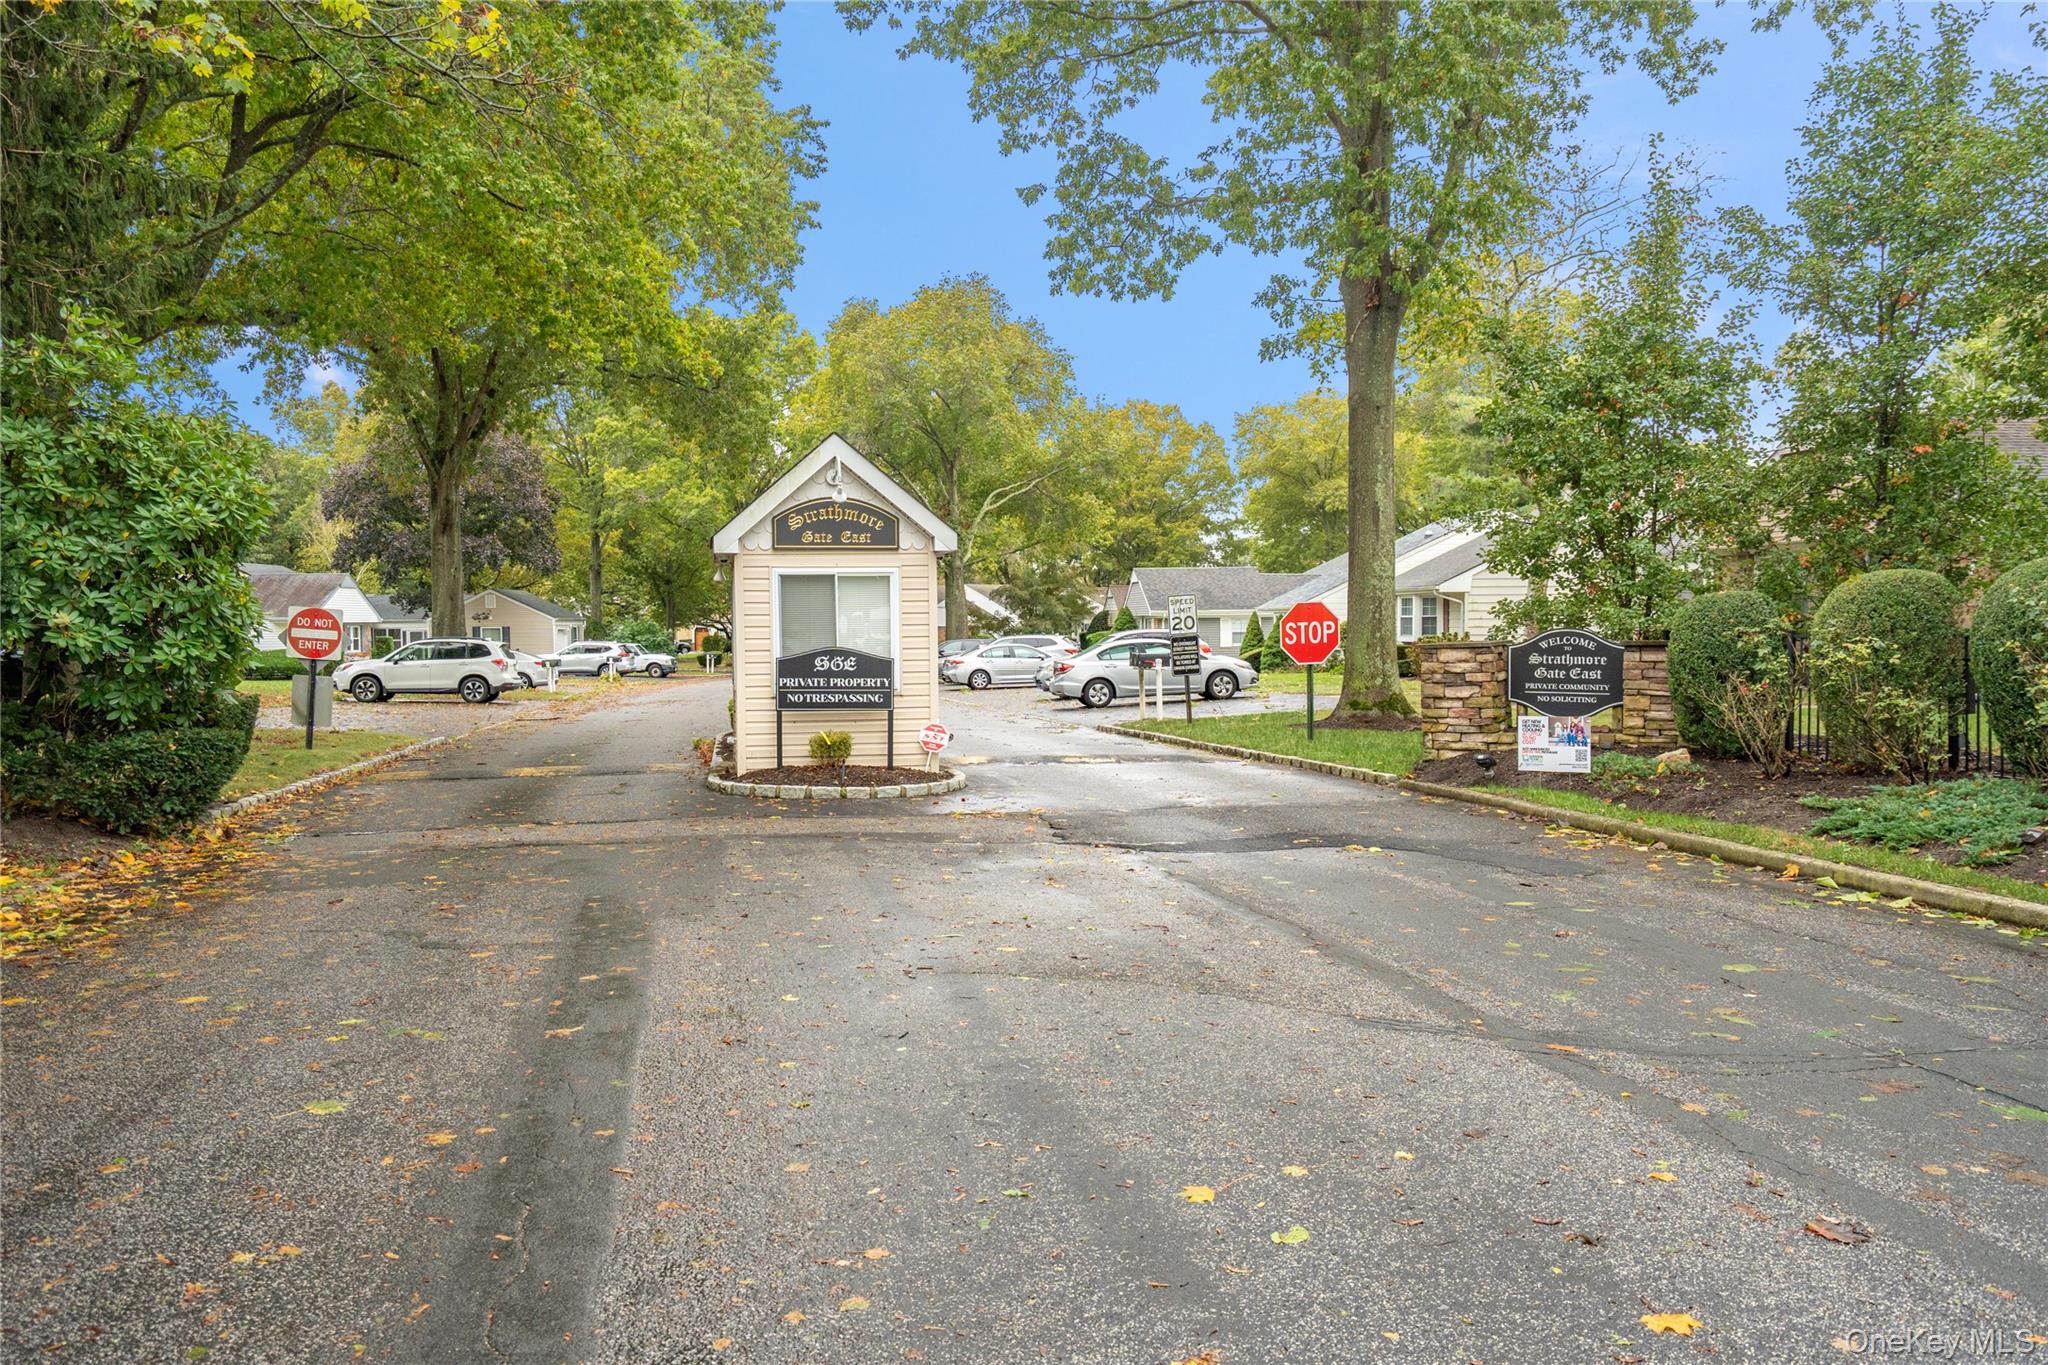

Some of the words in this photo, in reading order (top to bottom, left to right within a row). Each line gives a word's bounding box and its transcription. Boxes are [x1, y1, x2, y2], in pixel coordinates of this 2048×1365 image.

[787, 503, 885, 531] Strathmore
[801, 531, 833, 543] Gate
[840, 531, 872, 543] East
[1173, 607, 1192, 615] LIMIT
[297, 616, 311, 627] DO
[314, 618, 333, 628] NOT
[1172, 616, 1195, 631] 20
[1284, 620, 1336, 645] STOP
[298, 639, 329, 650] ENTER
[1538, 636, 1597, 651] WELCOME
[813, 655, 857, 672] SGE
[1528, 652, 1608, 667] Strathmore
[1534, 666, 1566, 679] Gate
[1569, 667, 1602, 680] East
[779, 677, 828, 687] PRIVATE
[829, 677, 891, 688] PROPERTY
[1525, 682, 1558, 690] PRIVATE
[1558, 683, 1610, 691] COMMUNITY
[786, 693, 803, 703] NO
[804, 693, 884, 703] TRESPASSING
[1537, 695, 1550, 703] NO
[1551, 695, 1597, 704] SOLICITING
